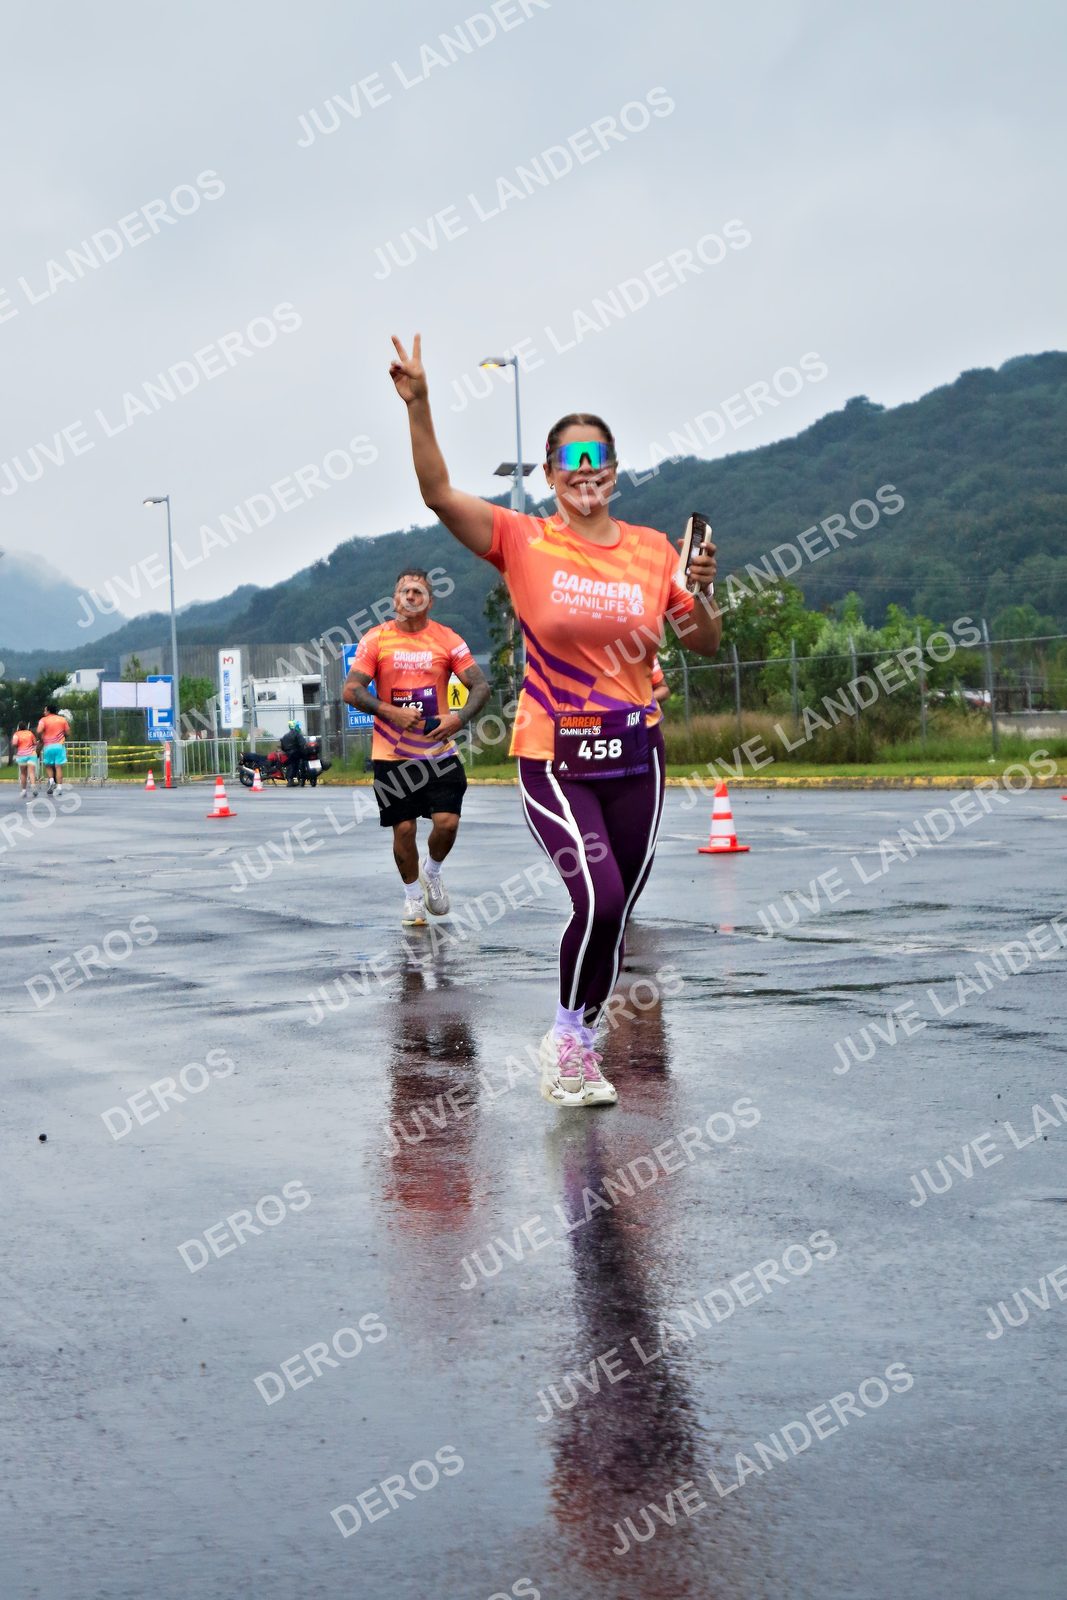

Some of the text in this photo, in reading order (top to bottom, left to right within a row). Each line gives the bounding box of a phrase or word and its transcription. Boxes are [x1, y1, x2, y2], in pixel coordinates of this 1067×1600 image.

[552, 570, 643, 603] CARRERA
[551, 590, 625, 614] OMNILIFE
[394, 650, 432, 661] CARRERA
[350, 714, 374, 724] ENTRAD
[560, 716, 602, 727] CARRERA
[560, 728, 592, 736] OMNILIFE
[578, 738, 622, 760] 458
